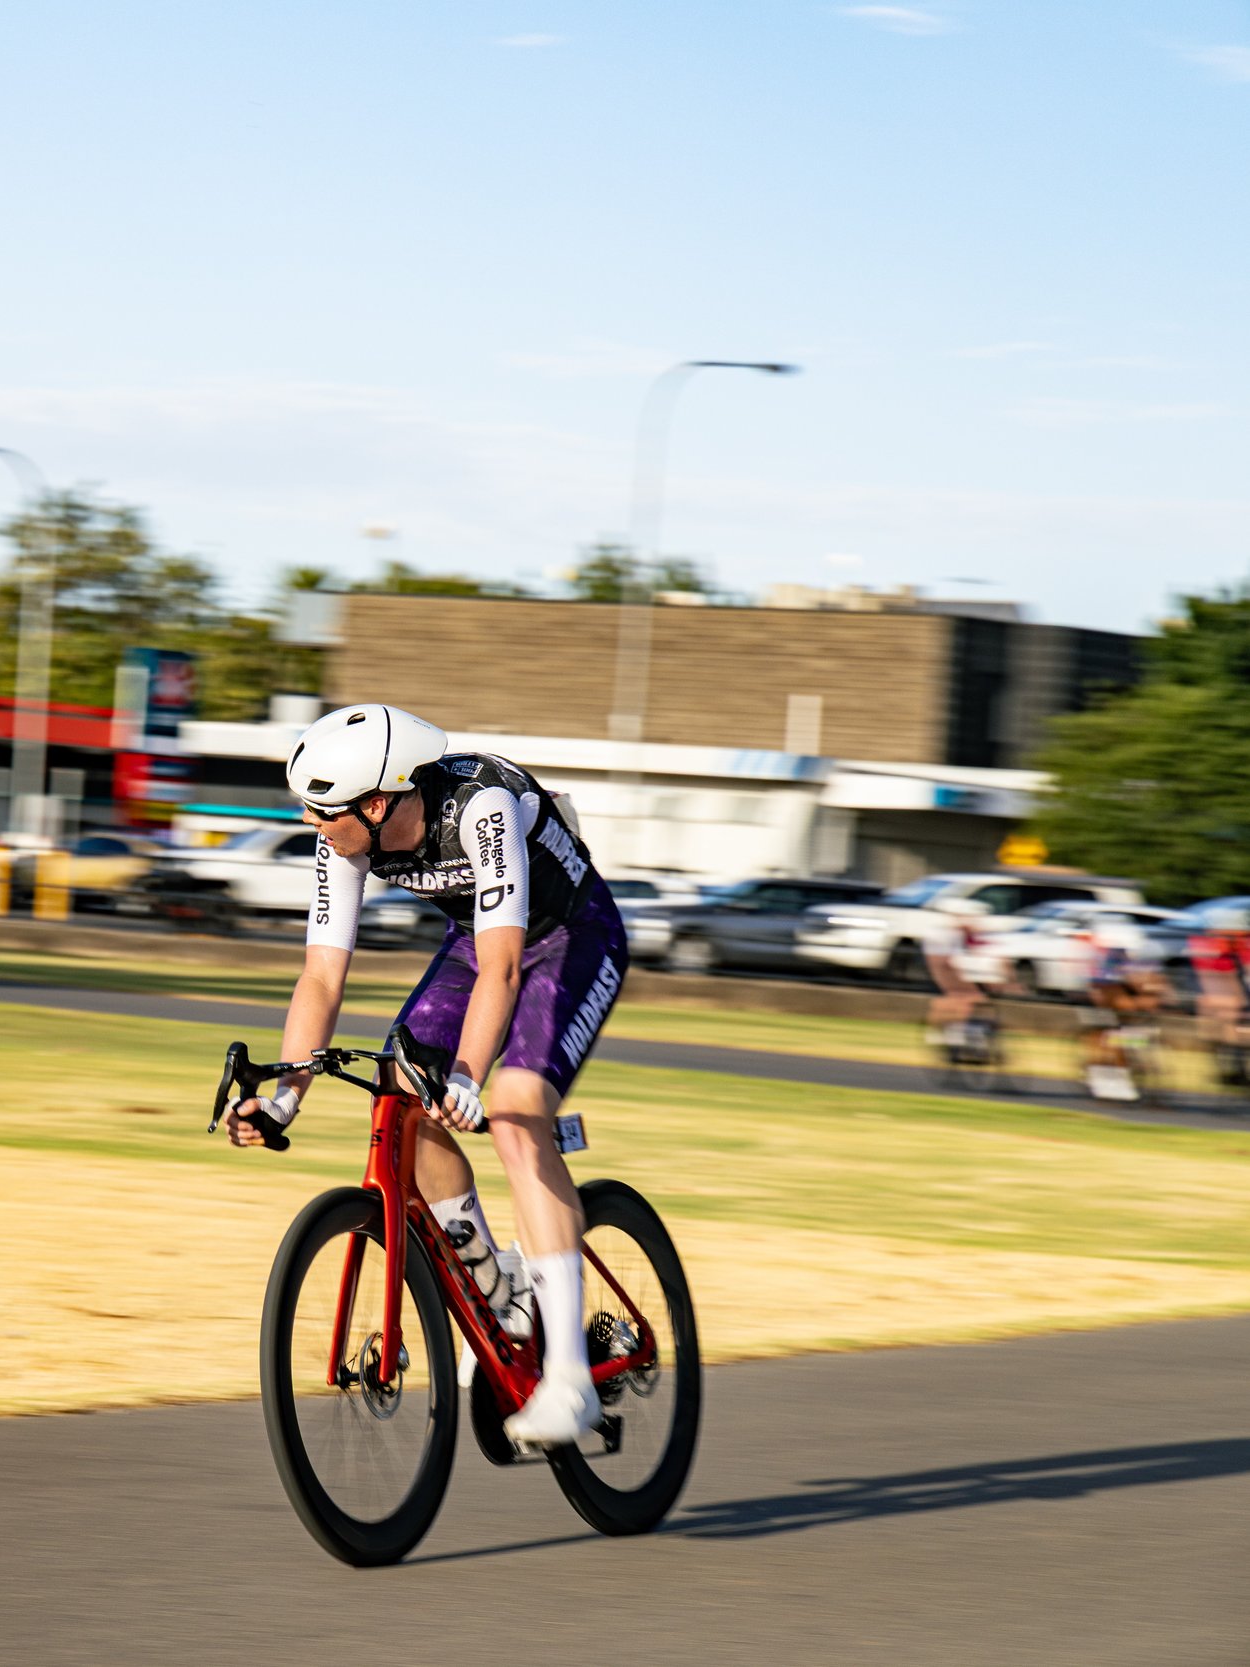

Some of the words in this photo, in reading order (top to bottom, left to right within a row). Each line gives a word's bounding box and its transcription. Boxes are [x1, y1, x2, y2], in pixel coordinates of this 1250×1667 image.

[475, 817, 492, 868] Coffee
[433, 857, 470, 870] STONEWA
[386, 868, 476, 891] HOLDFAS
